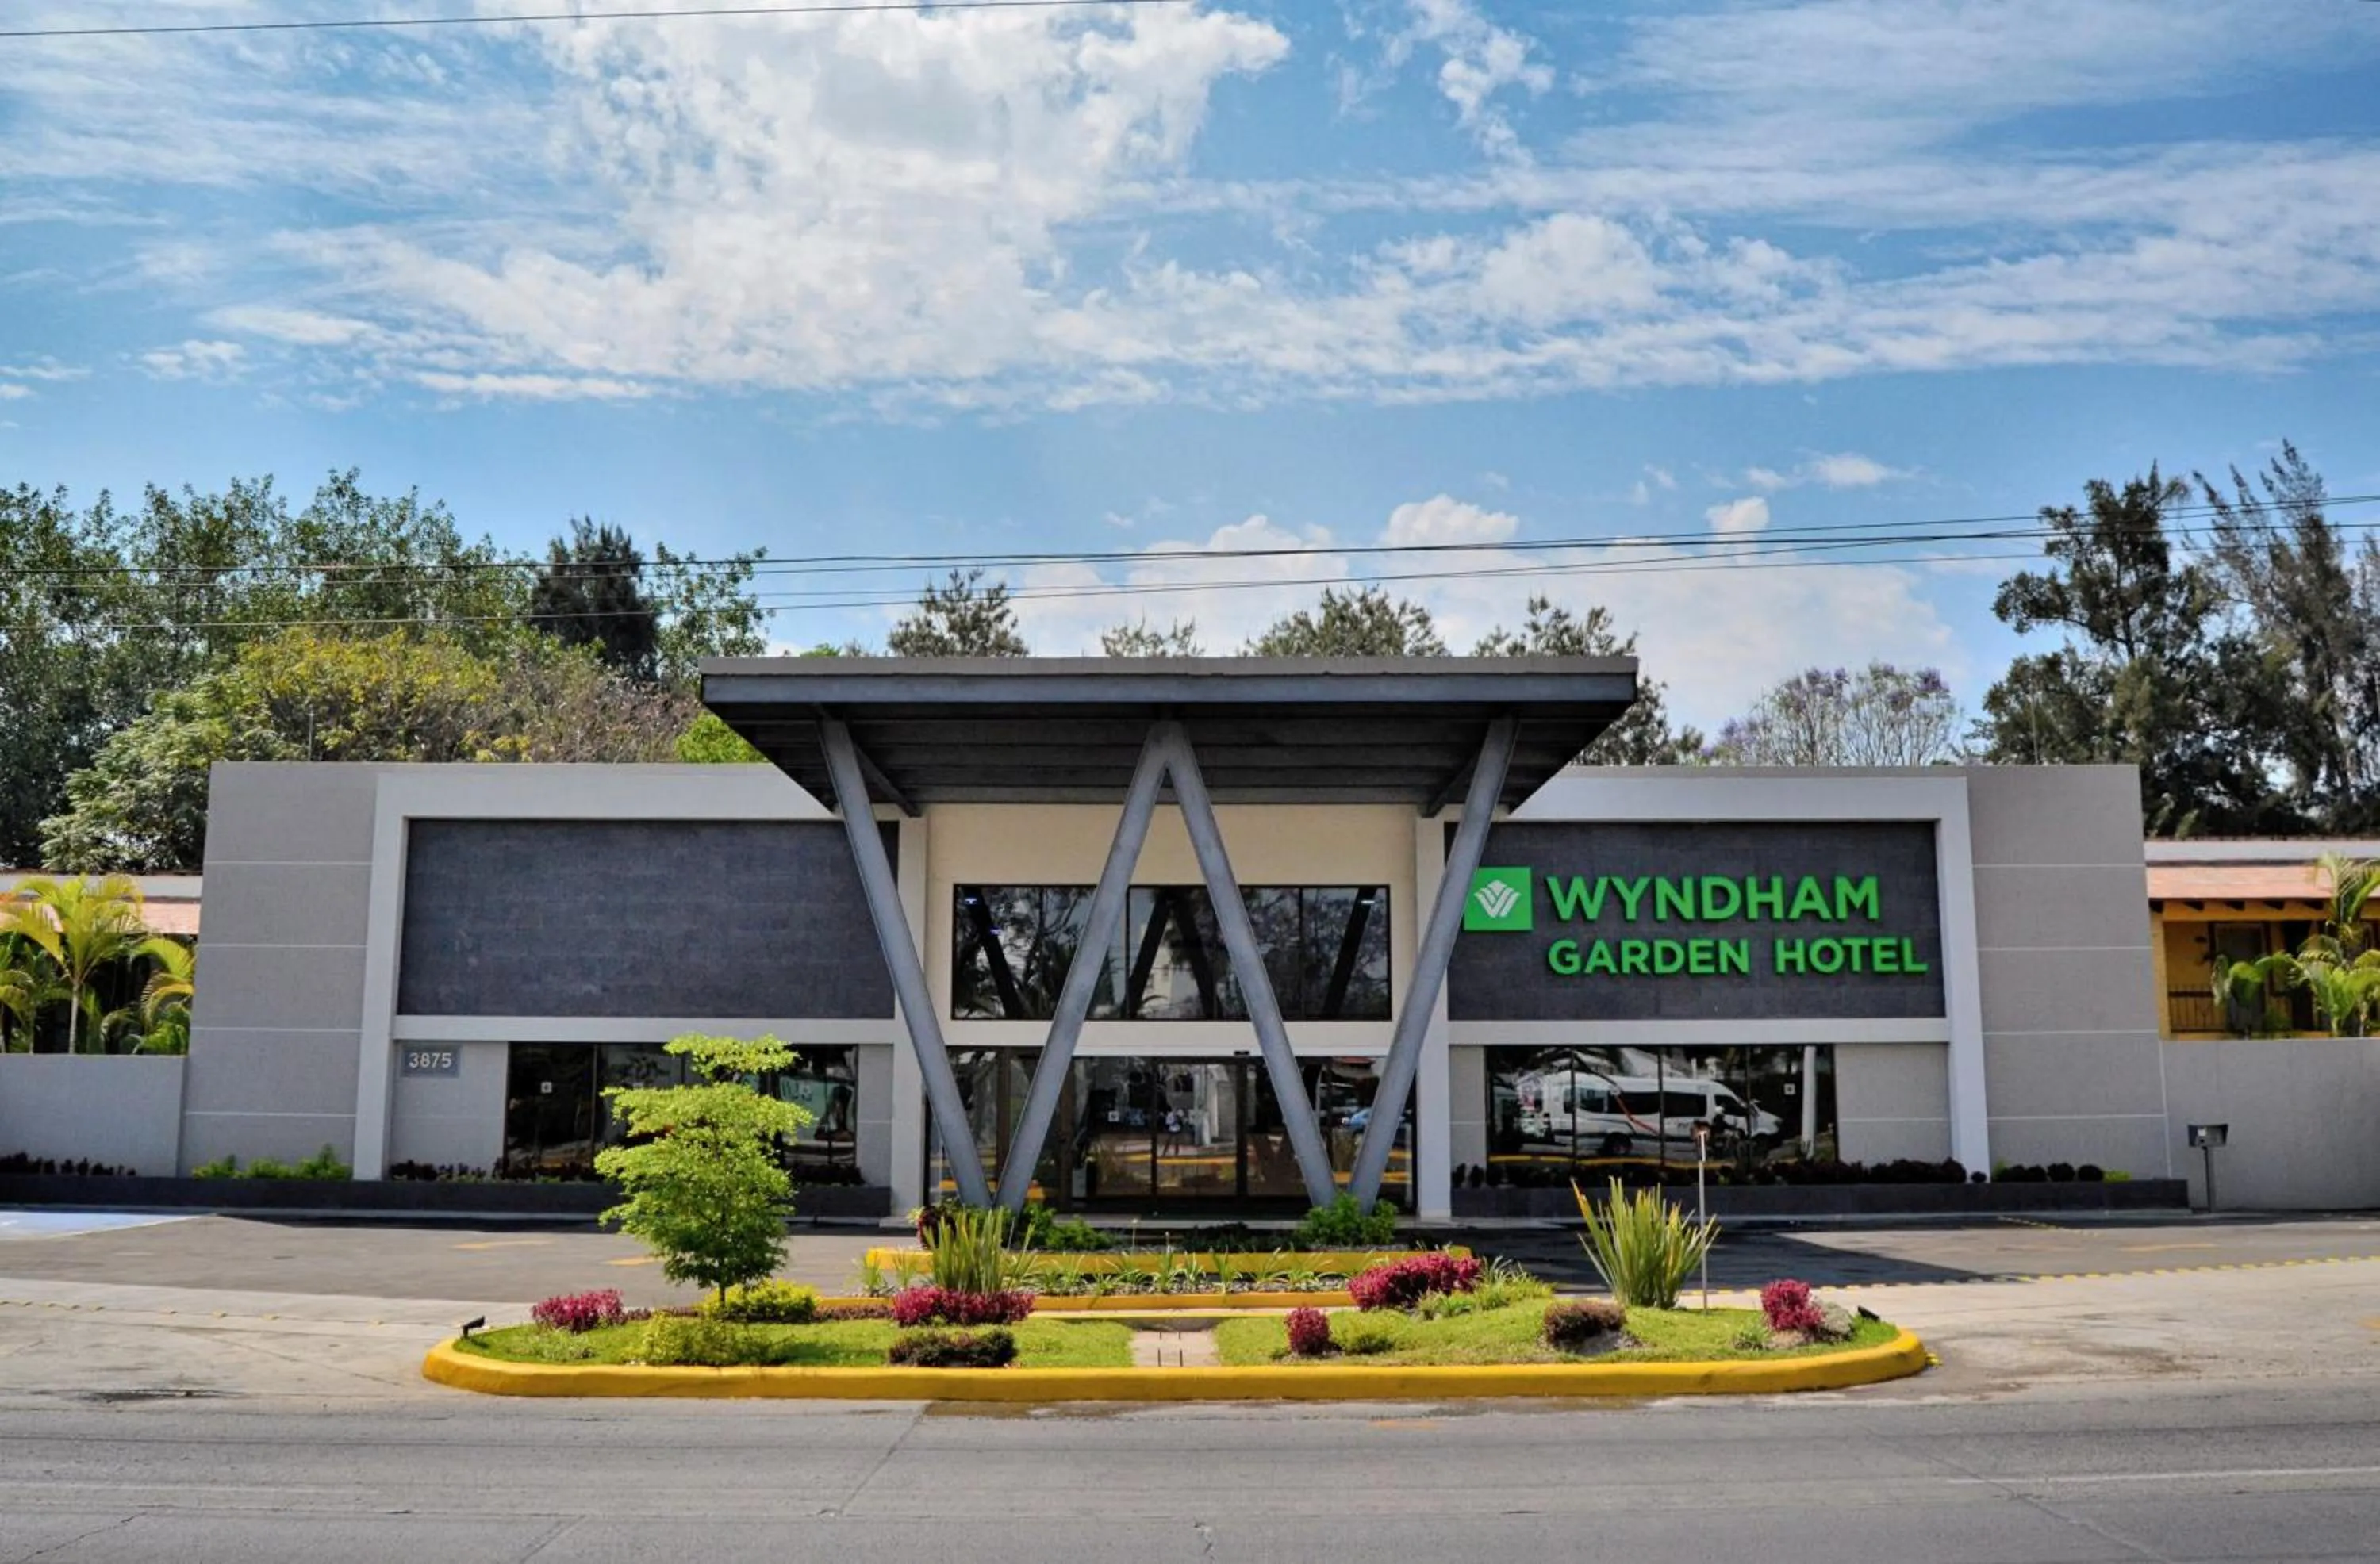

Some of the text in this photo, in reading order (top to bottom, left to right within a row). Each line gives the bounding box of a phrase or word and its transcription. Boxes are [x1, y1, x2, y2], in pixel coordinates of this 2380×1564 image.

[1547, 875, 1880, 921] WYNDHAM
[1547, 937, 1929, 975] GARDEN HOTEL
[409, 1052, 452, 1069] 3875
